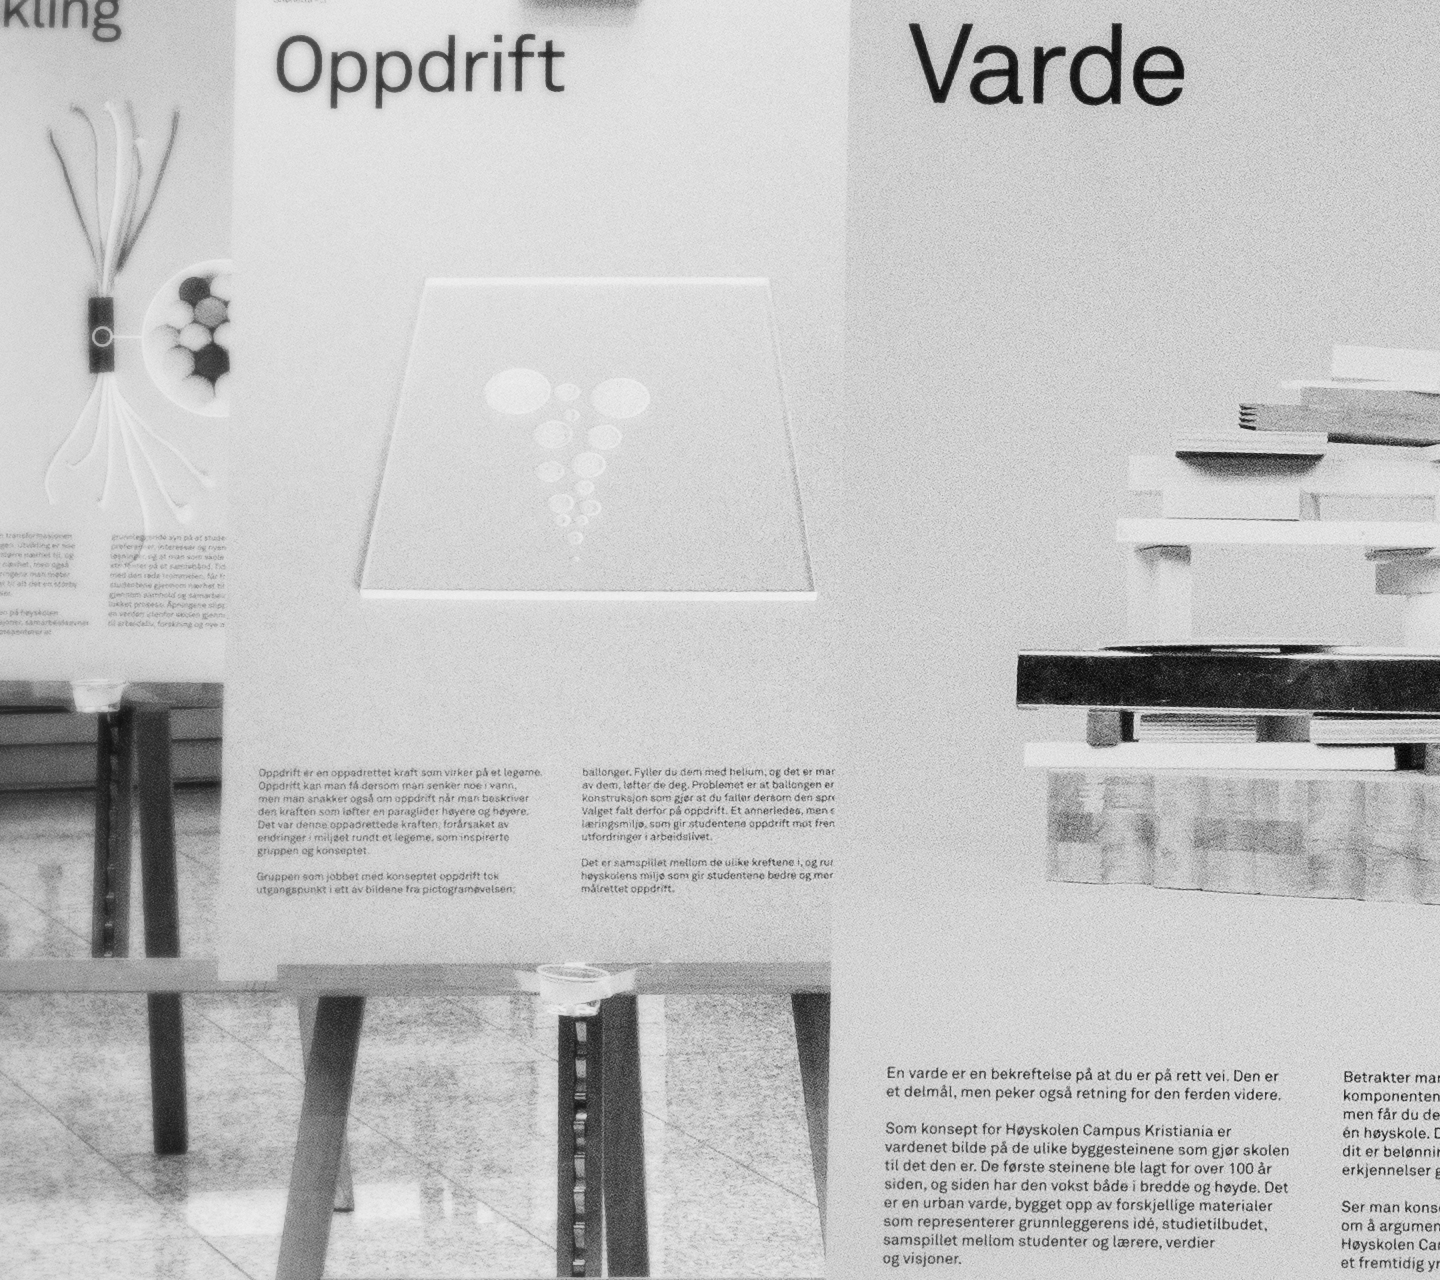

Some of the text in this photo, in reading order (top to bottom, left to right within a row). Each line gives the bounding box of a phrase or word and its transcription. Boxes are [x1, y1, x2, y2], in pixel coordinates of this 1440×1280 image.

[275, 33, 566, 109] Oppdrift
[909, 23, 1185, 107] Varde
[886, 1064, 1279, 1085] En varde er en bekreftelse på at du er på rett vei. Den er
[1343, 1069, 1411, 1084] Betrakter
[885, 1082, 1281, 1103] et delmål, men peker også retning for den ferden videre.
[885, 1119, 1232, 1140] Som konsept for Høyskolen Campus Kristiania er
[1342, 1123, 1360, 1138] én
[1363, 1124, 1430, 1142] høyskole.
[884, 1138, 1290, 1160] vardenet bilde på de ulike byggesteinene som gjør skolen
[883, 1195, 1273, 1215] er en urban varde, bygget opp av forskjellige materialer
[1341, 1199, 1366, 1213] Ser
[1369, 1203, 1401, 1213] man
[883, 1213, 1268, 1233] som representerer grunnleggerens idé, studietilbudet,
[1340, 1236, 1415, 1254] Høyskolen
